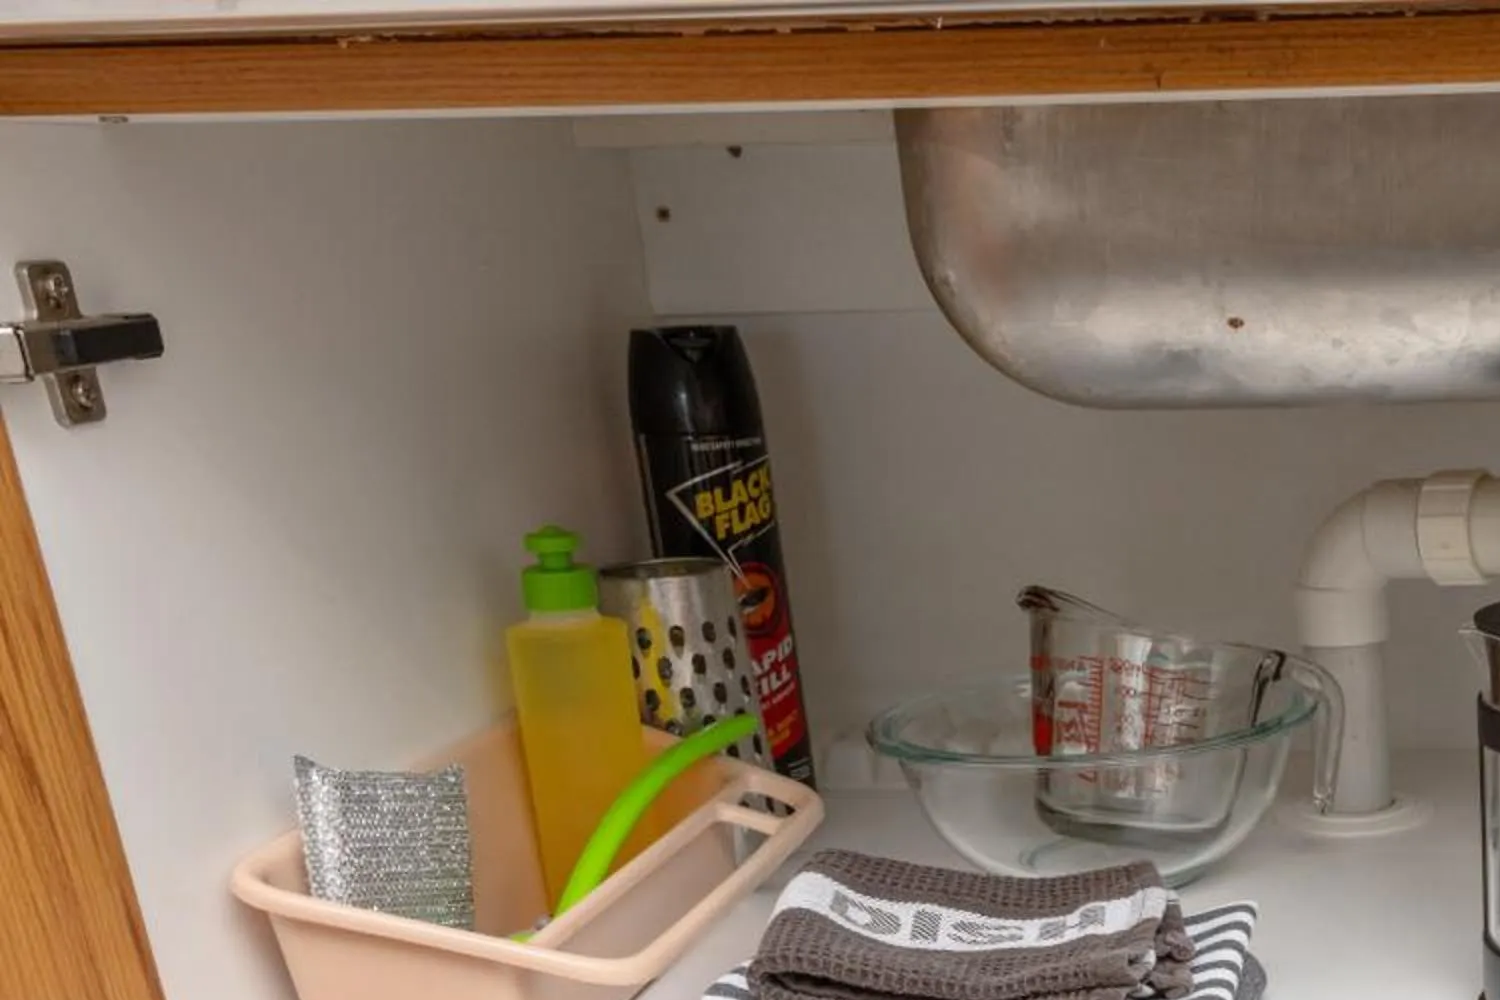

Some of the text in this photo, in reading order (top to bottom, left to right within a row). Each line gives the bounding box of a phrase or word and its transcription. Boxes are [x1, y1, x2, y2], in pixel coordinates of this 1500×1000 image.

[695, 464, 769, 519] BLACK
[715, 494, 770, 540] FLAG
[751, 636, 792, 676] APID
[757, 662, 791, 696] ILL
